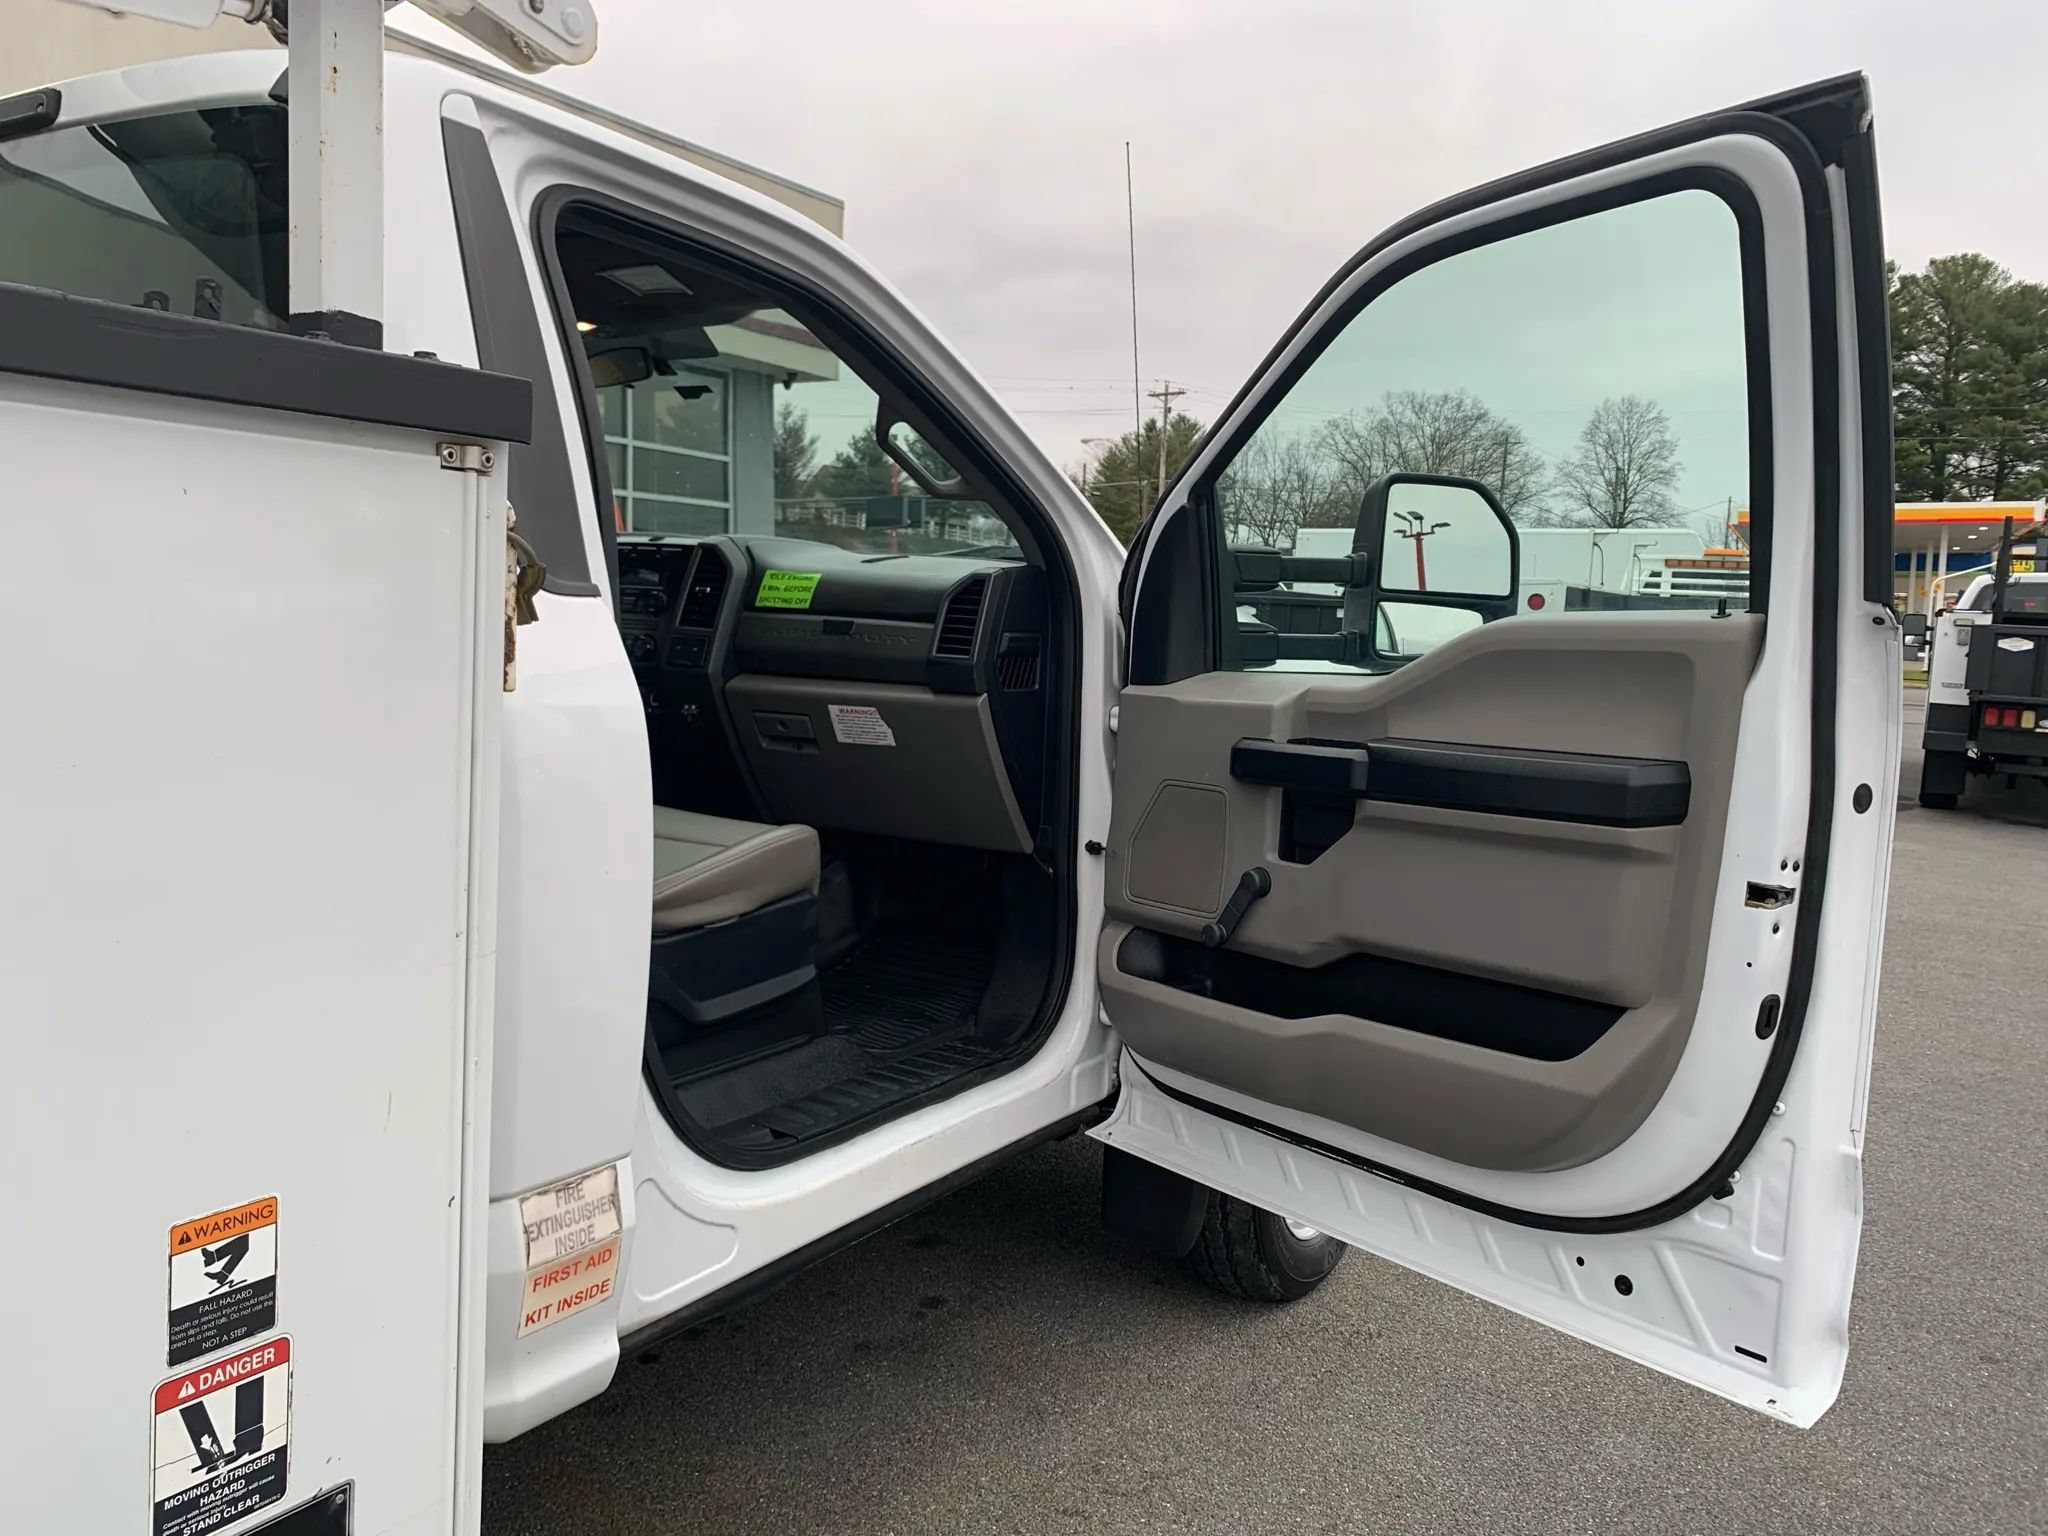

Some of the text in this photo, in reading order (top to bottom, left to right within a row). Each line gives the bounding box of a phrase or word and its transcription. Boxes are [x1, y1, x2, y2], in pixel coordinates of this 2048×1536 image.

[555, 1183, 585, 1208] FIRE
[194, 1204, 274, 1240] WARNING
[527, 1193, 616, 1242] EXTINGUISHER
[555, 1224, 595, 1256] INSIDE
[533, 1248, 613, 1293] FIRST AID
[170, 1321, 192, 1334] Death
[200, 1311, 222, 1323] serious
[239, 1297, 258, 1309] could
[199, 1289, 253, 1314] FALL HAZARD
[525, 1279, 611, 1328] KIT INSIDE
[201, 1320, 215, 1331] and
[230, 1312, 240, 1320] Do
[202, 1336, 220, 1349] NOT
[221, 1334, 229, 1342] A
[229, 1326, 248, 1339] STEP
[199, 1347, 276, 1391] DANGER
[164, 1453, 276, 1511] MOVING OUTRIGGER
[200, 1479, 246, 1507] HAZARD
[183, 1512, 221, 1536] STAND
[223, 1494, 260, 1518] CLEAR
